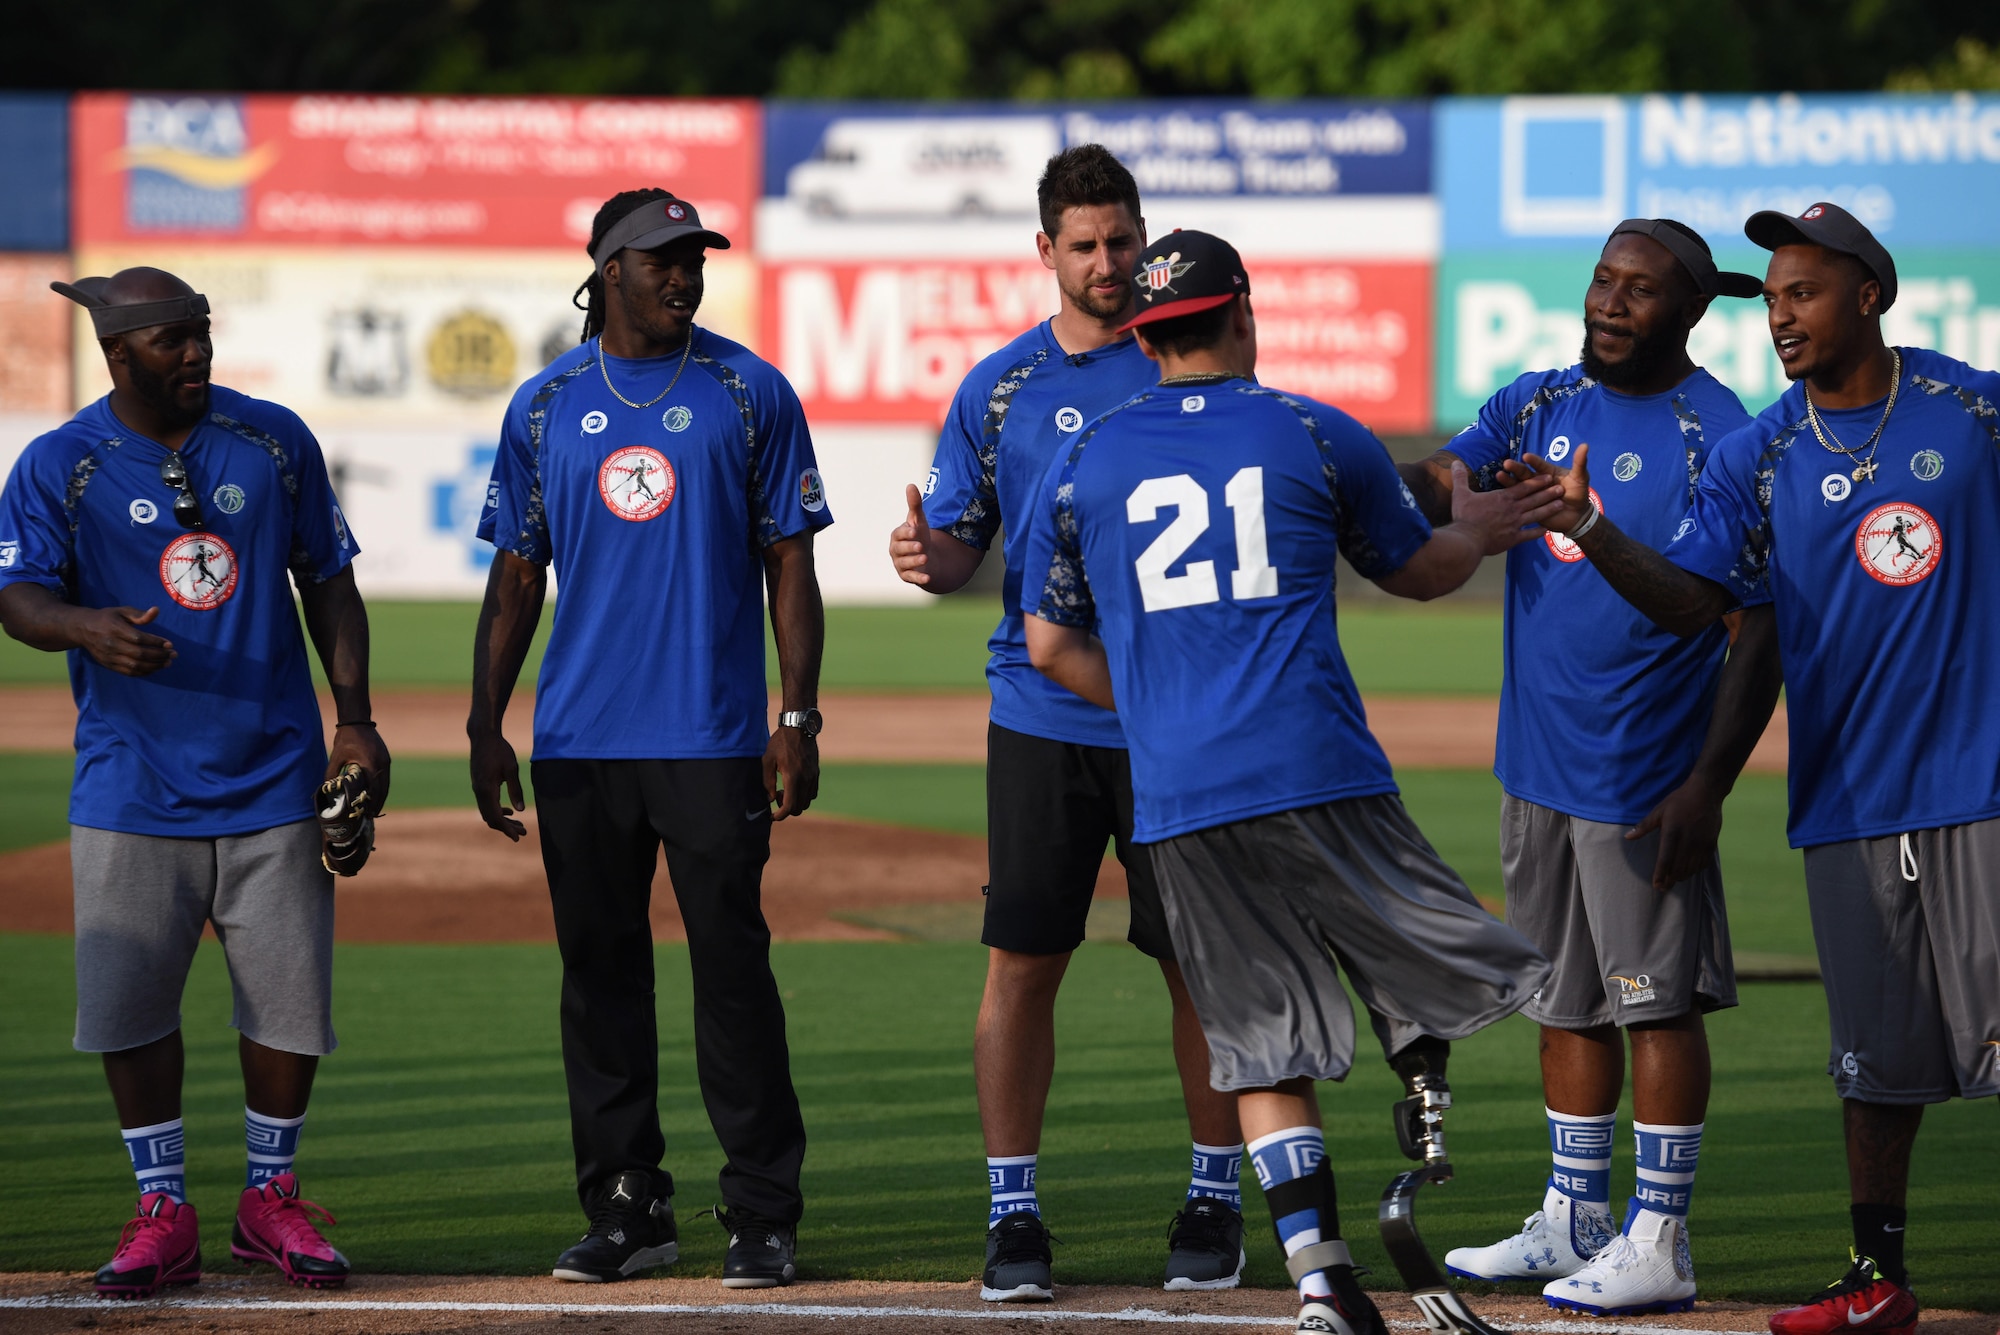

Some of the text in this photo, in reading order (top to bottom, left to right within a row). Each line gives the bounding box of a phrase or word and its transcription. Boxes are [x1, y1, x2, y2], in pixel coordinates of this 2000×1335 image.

[802, 491, 821, 506] CSN
[1126, 466, 1279, 613] 21
[1858, 505, 1941, 572] THE AMPUTEE WARRIOR CHARITY SOFTBALL CLASSIC 2015
[1907, 574, 1921, 582] AND
[1636, 1184, 1687, 1206] URE
